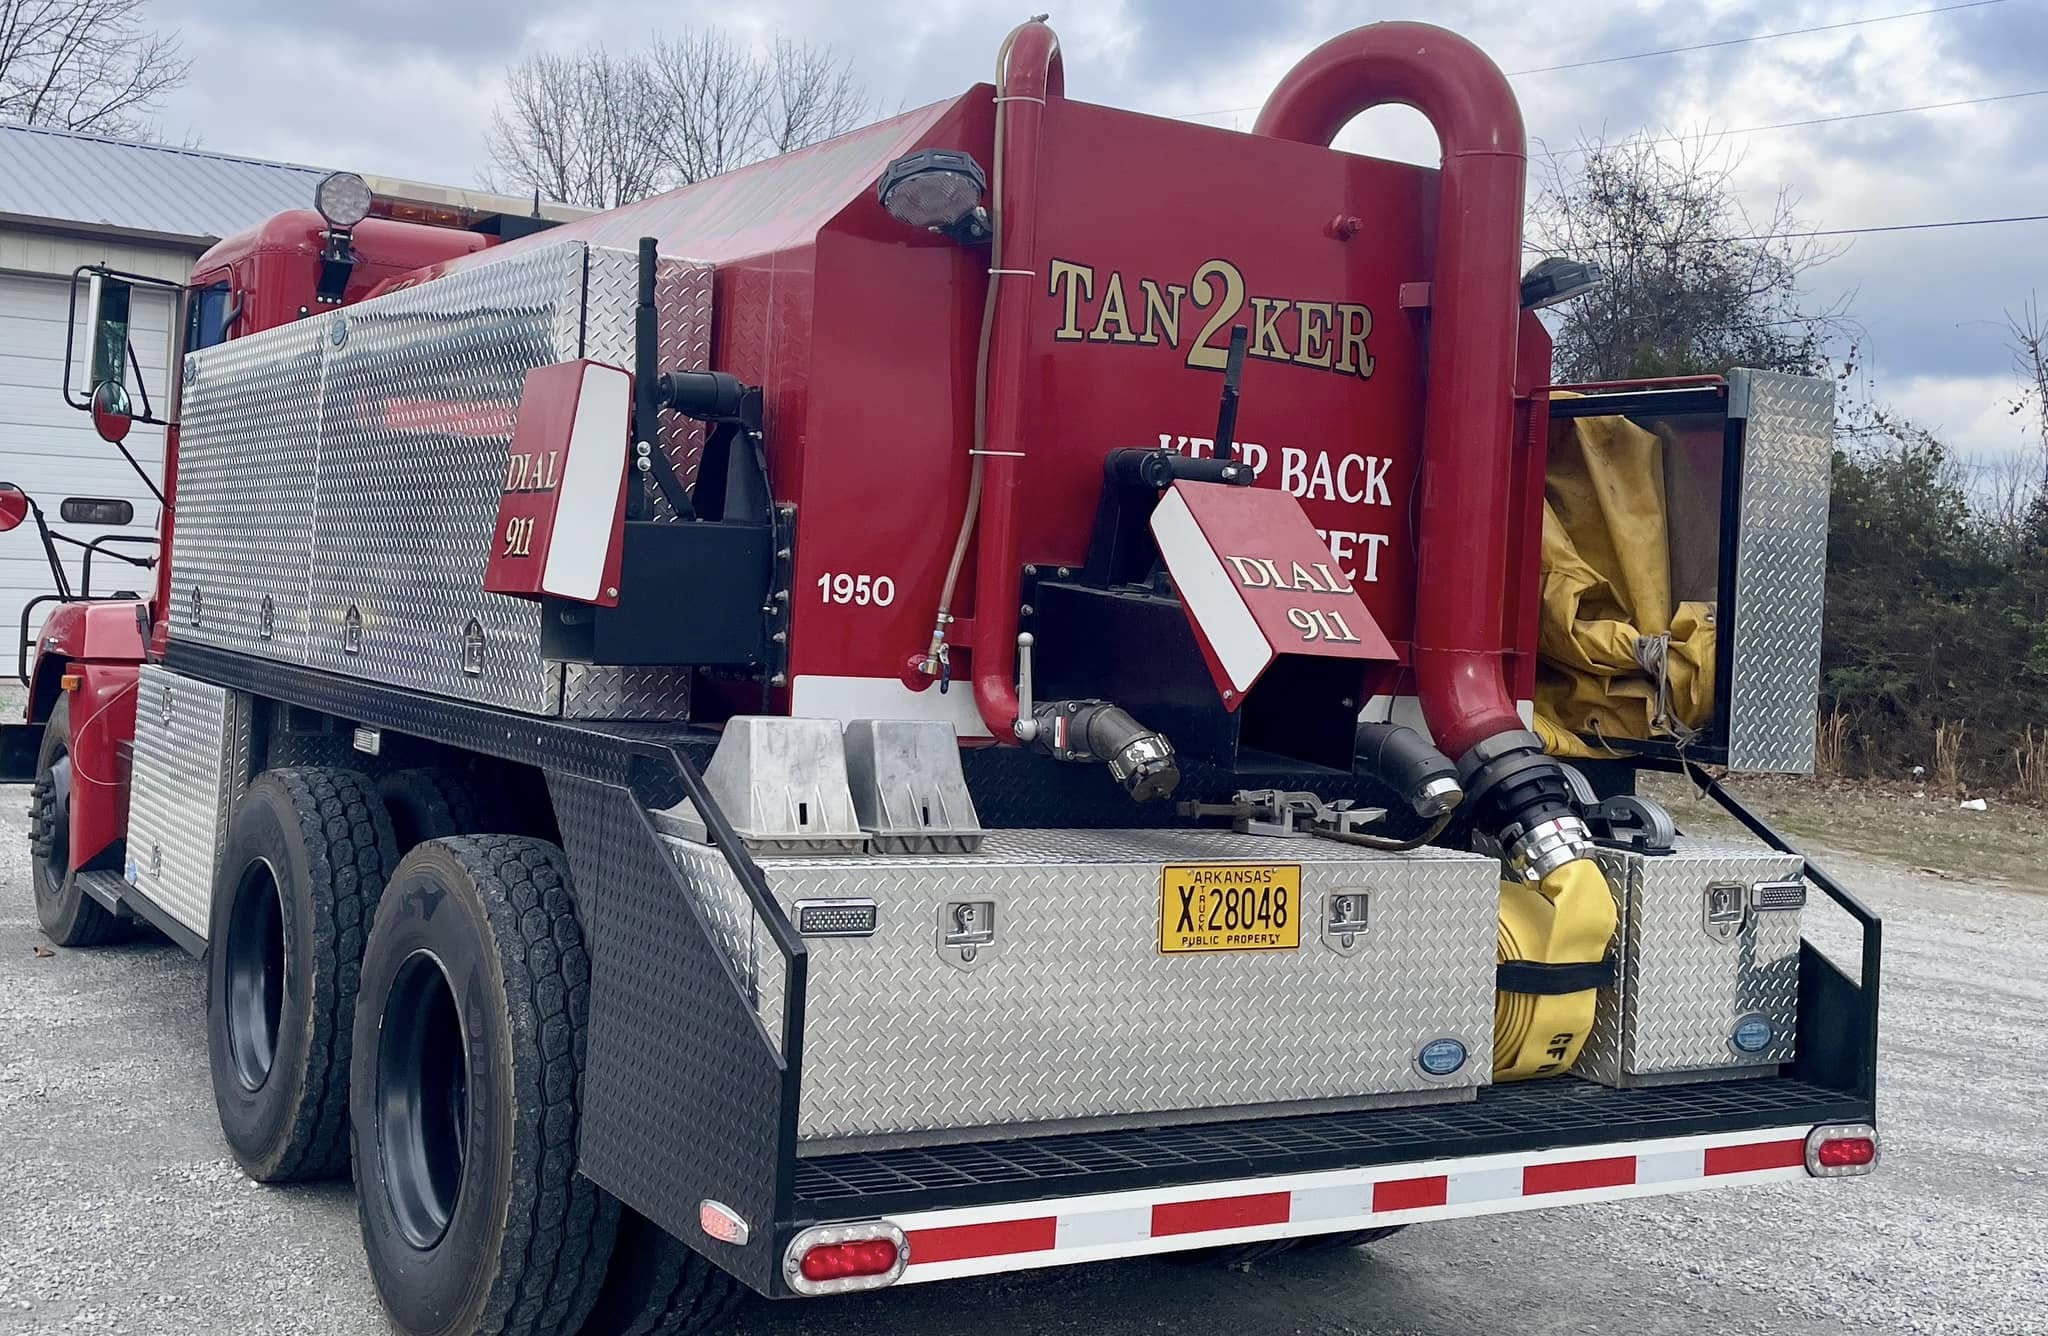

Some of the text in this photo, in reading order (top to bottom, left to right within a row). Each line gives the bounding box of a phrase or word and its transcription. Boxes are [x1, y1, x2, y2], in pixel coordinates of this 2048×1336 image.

[503, 451, 558, 492] DIAL
[1281, 447, 1393, 506] BACK
[502, 516, 535, 557] 911
[817, 572, 895, 607] 1950
[1225, 555, 1354, 594] DIAL
[1287, 607, 1362, 643] 911
[1193, 870, 1272, 884] ARKANSAS
[1198, 885, 1206, 932] TRUCK
[1207, 886, 1288, 931] 28048
[1182, 934, 1281, 946] PUBLIC PROPERTY
